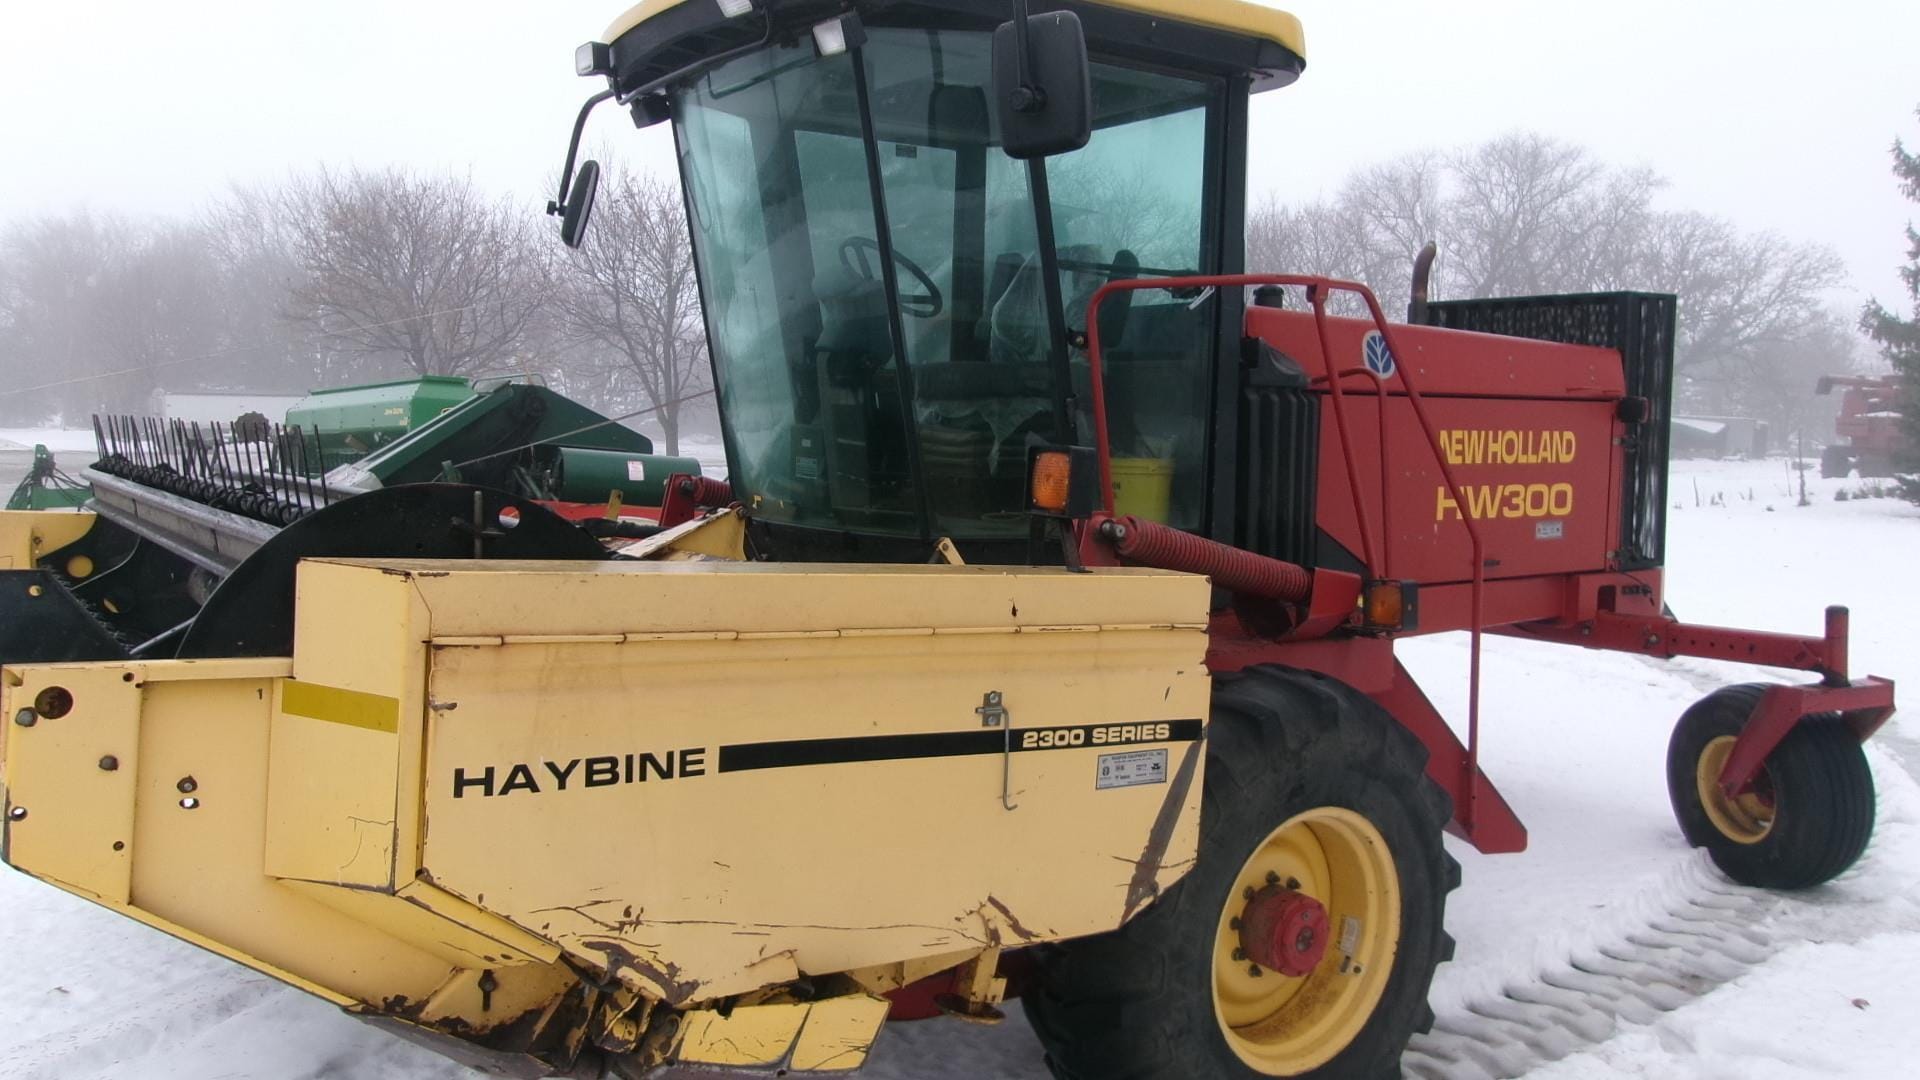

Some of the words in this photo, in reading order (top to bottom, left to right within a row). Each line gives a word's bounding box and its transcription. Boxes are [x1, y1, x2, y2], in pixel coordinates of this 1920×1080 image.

[1439, 430, 1485, 464] NEW
[1487, 430, 1576, 464] HOLLAND
[1436, 483, 1573, 521] HW300
[1022, 729, 1085, 748] 2300
[1092, 723, 1170, 744] SERIES
[453, 747, 706, 799] HAYBINE
